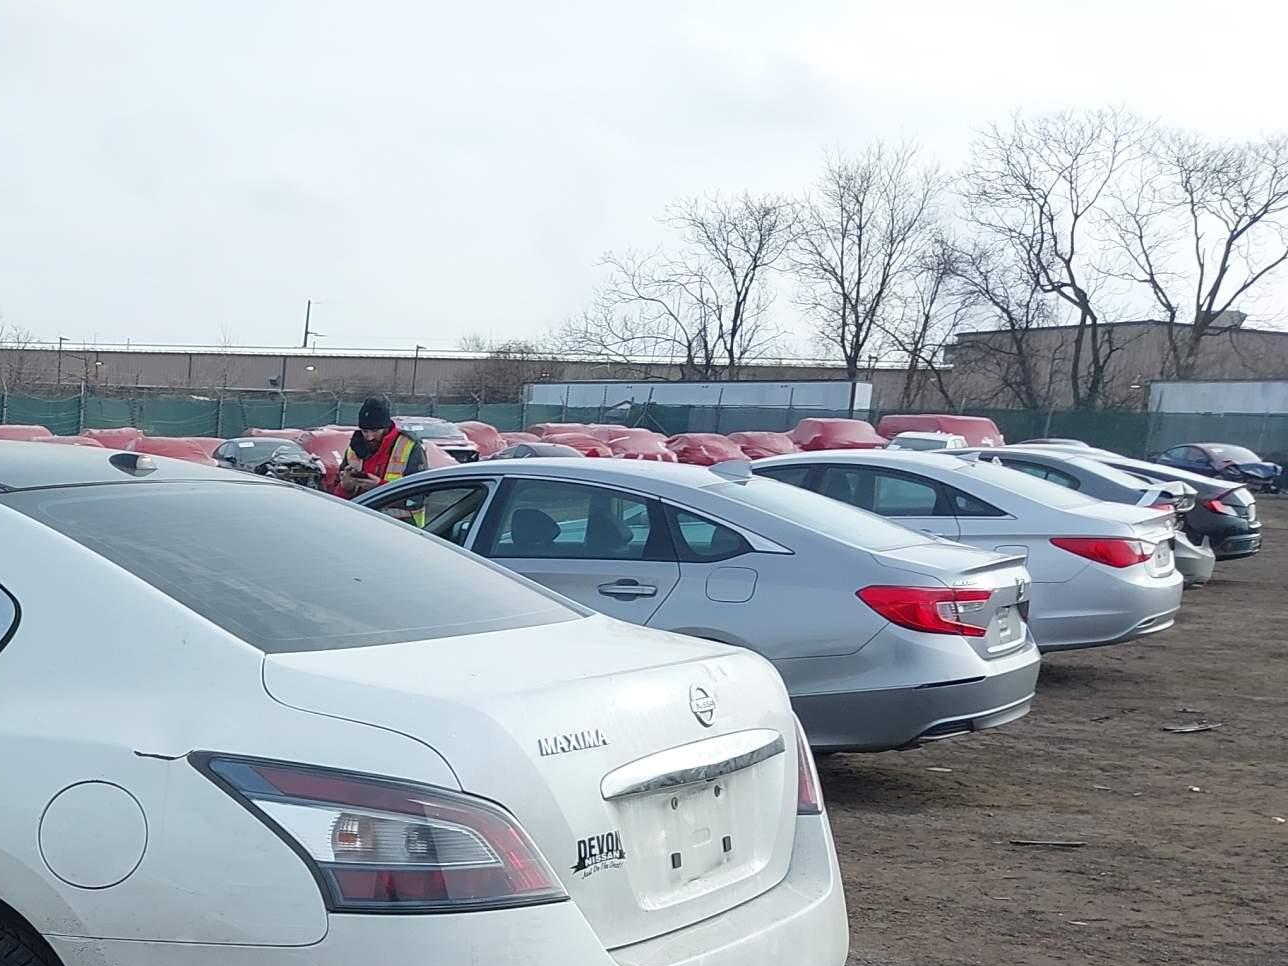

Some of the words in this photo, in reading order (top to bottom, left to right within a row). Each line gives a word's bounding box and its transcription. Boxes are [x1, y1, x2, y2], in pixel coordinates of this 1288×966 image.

[537, 728, 610, 757] MAXIMA
[577, 830, 623, 862] DEVON
[584, 849, 621, 868] NISSAN
